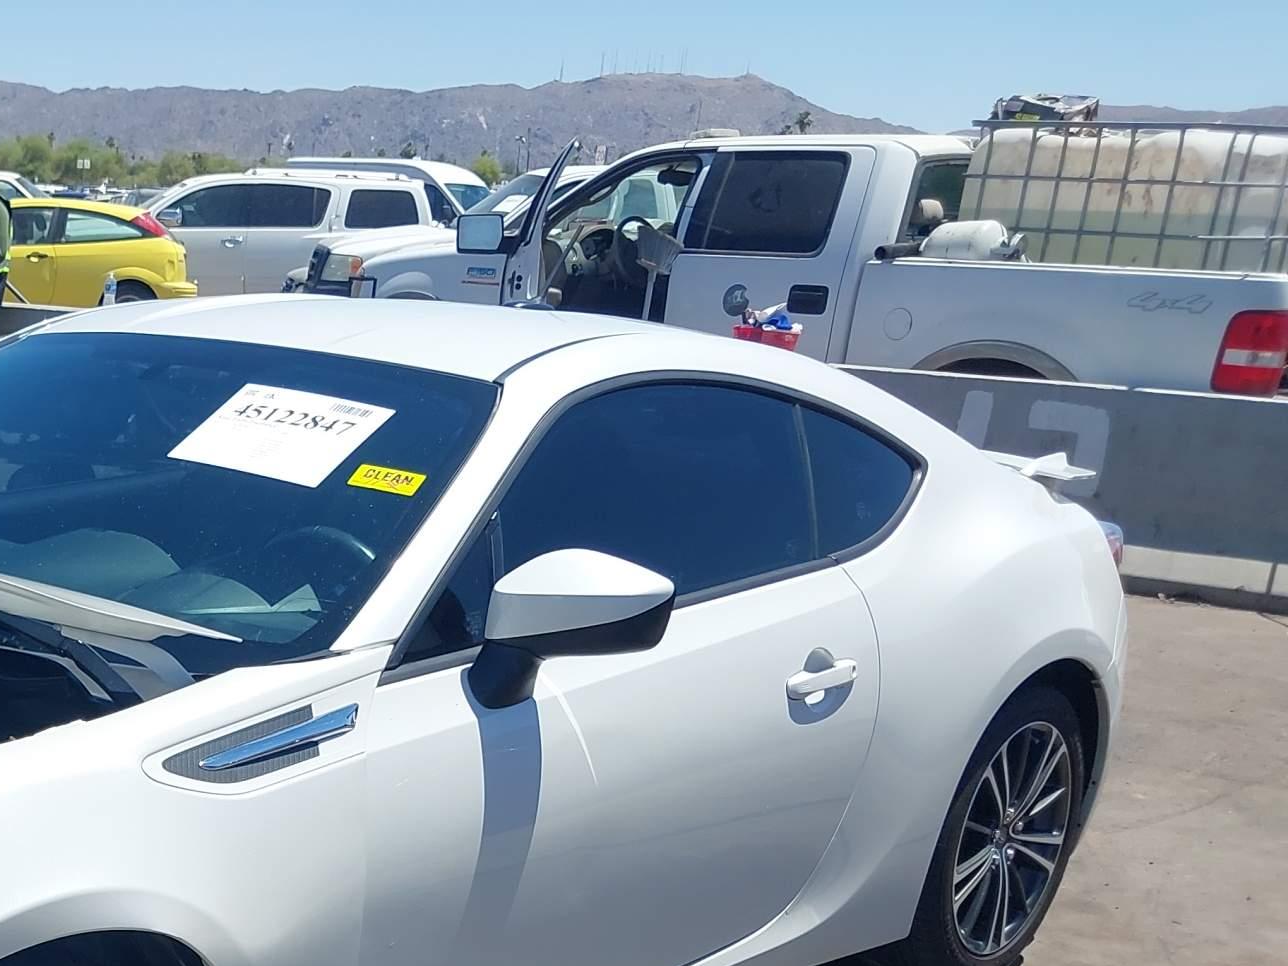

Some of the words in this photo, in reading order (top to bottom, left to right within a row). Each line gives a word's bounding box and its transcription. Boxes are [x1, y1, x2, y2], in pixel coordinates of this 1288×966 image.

[1126, 290, 1214, 315] 4x4
[233, 403, 358, 436] 45122847
[363, 468, 415, 486] CLEAN
